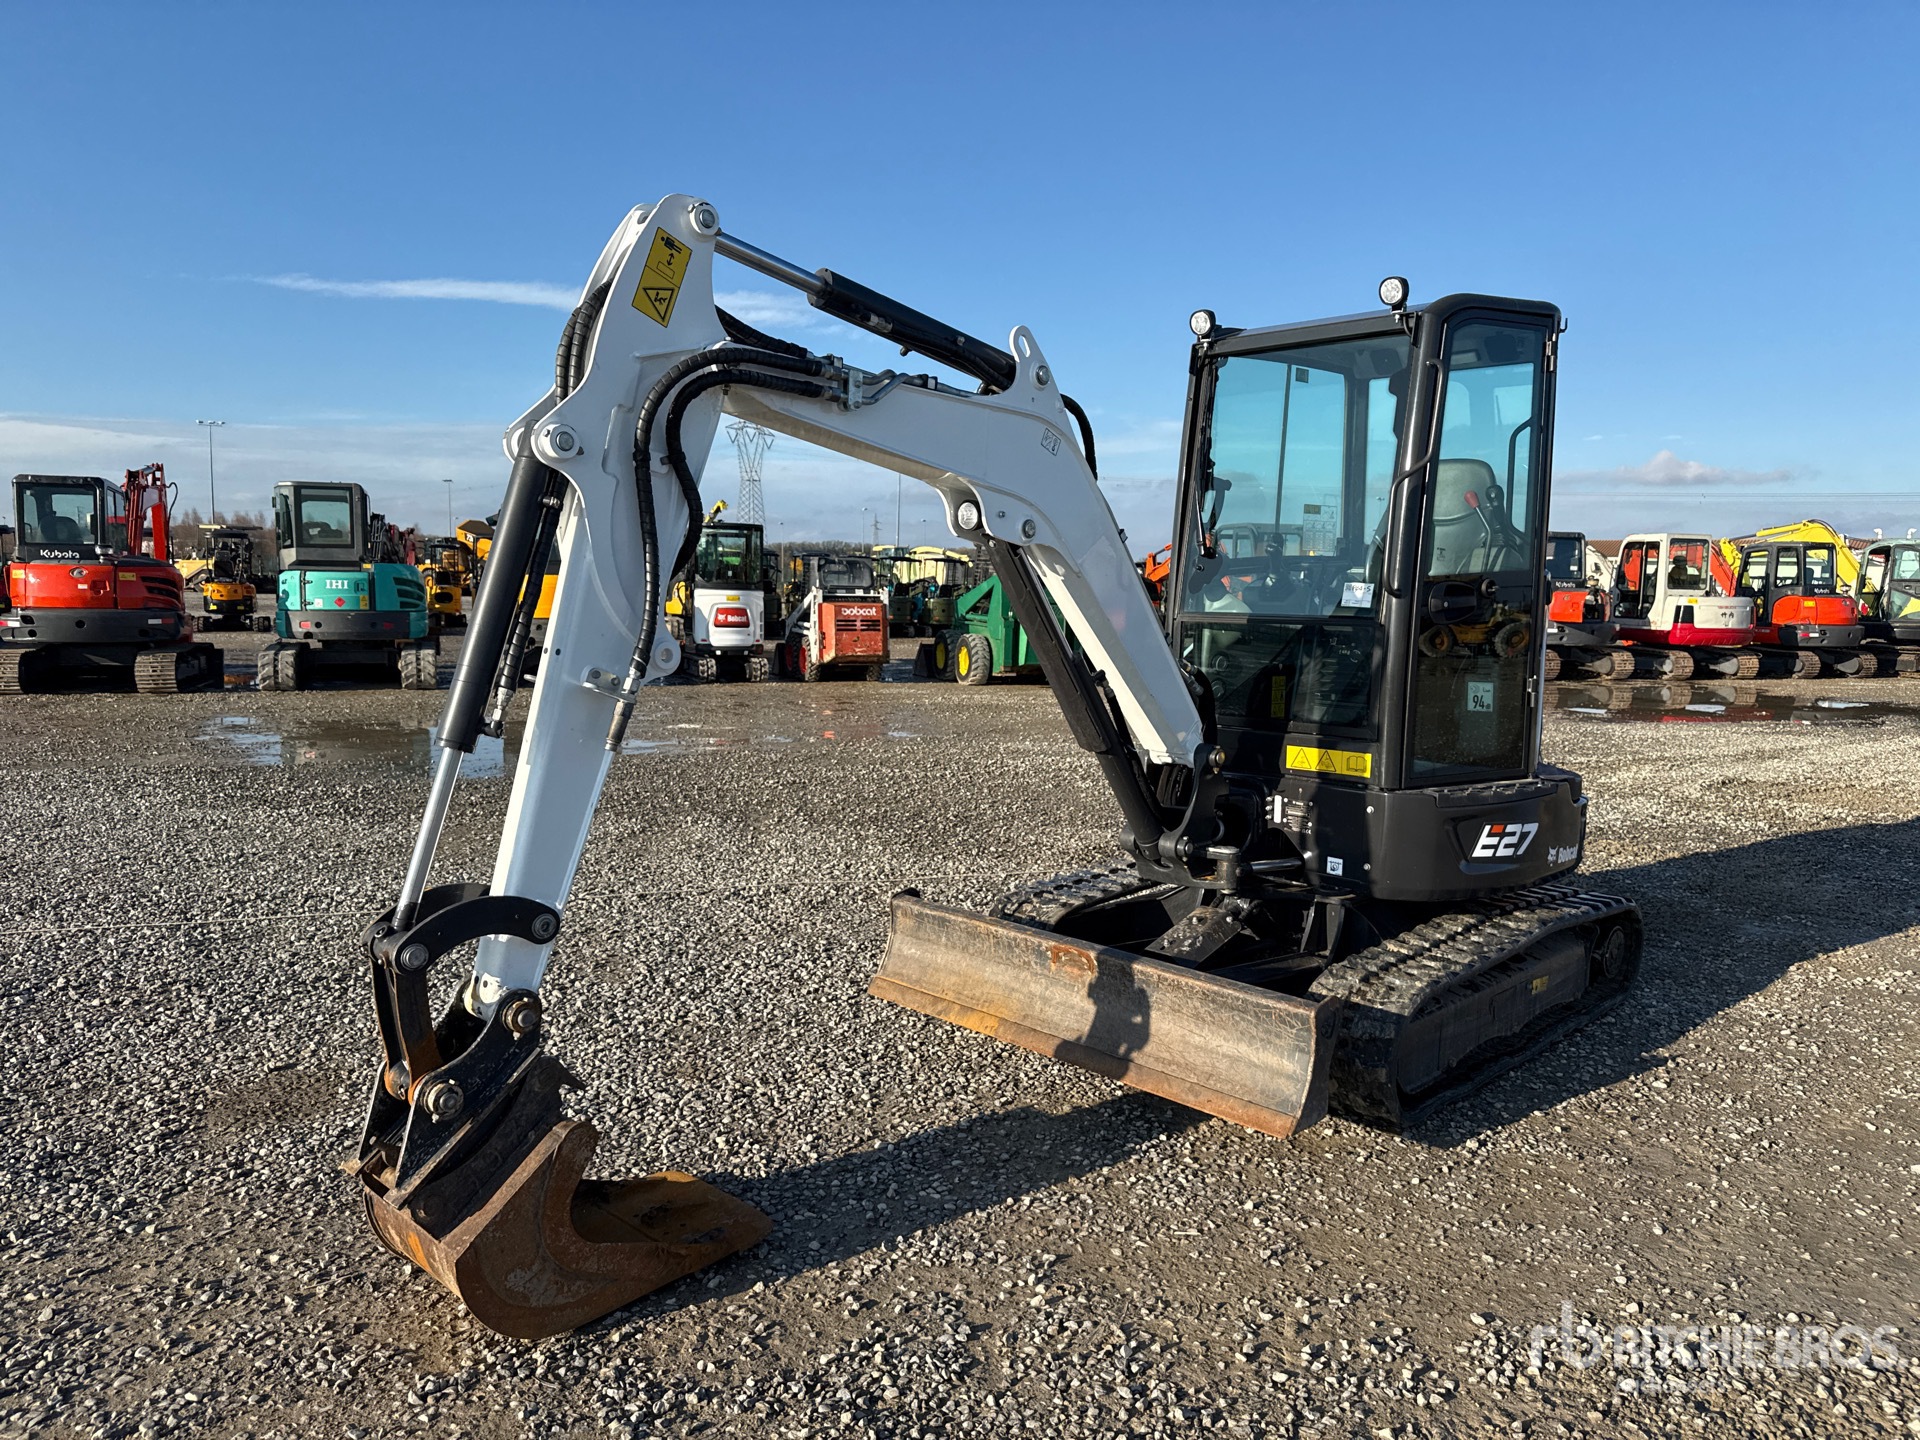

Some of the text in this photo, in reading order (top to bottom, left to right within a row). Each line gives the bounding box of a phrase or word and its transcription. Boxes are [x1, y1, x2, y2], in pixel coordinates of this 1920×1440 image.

[40, 549, 80, 559] Kubota
[325, 579, 349, 589] IHI
[727, 614, 747, 622] Bobcat
[1472, 694, 1485, 709] 94
[1471, 822, 1539, 857] E27
[1557, 843, 1579, 864] Bobcat
